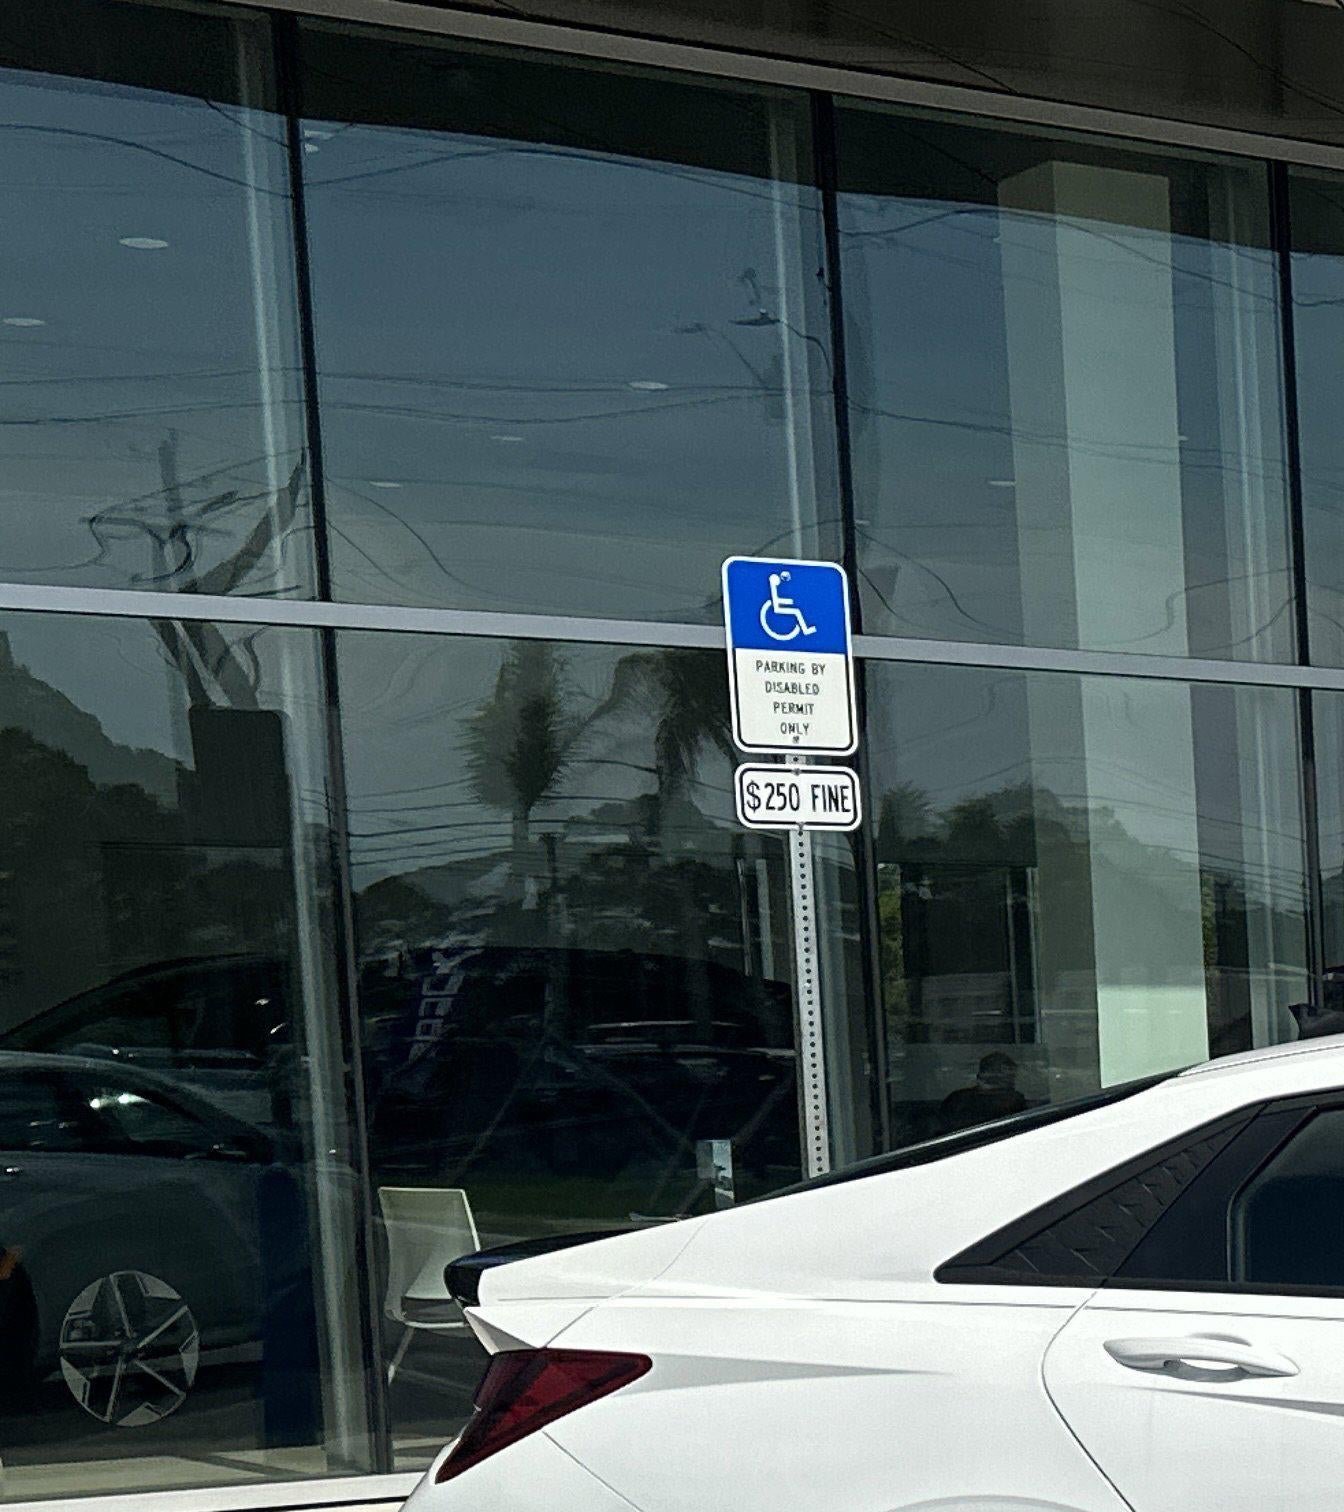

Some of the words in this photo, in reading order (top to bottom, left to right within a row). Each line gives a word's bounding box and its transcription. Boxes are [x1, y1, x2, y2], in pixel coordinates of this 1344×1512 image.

[756, 660, 805, 674] PARKING
[811, 663, 825, 675] BY
[765, 681, 819, 695] DISABLED
[773, 701, 814, 715] PERMIT
[780, 722, 809, 735] ONLY
[747, 781, 800, 812] $250
[811, 784, 851, 812] FINE
